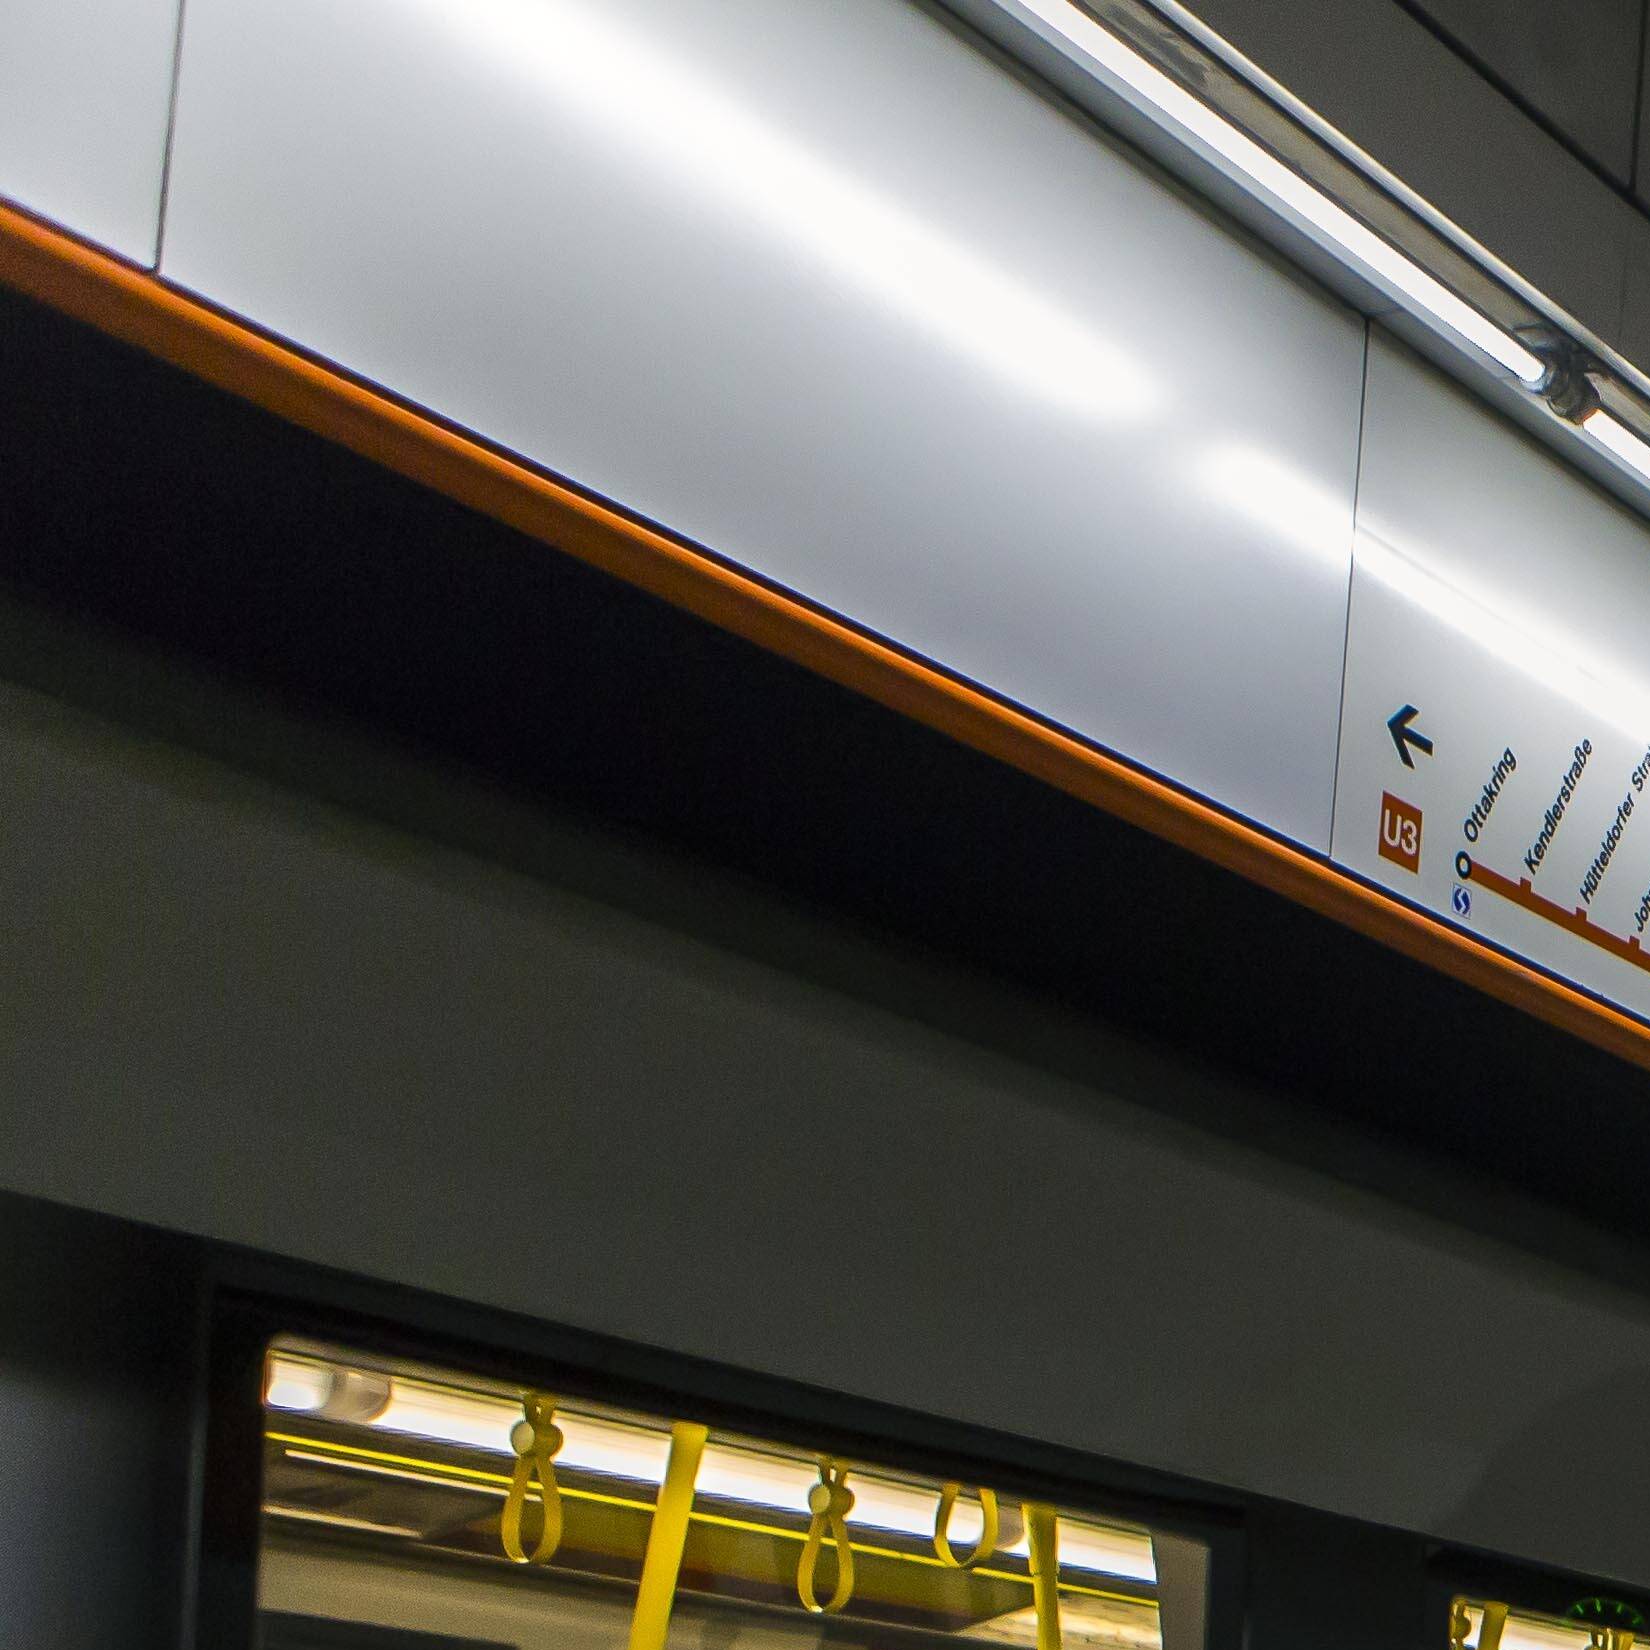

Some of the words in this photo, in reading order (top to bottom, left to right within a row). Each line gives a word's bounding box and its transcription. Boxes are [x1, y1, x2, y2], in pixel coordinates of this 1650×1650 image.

[1383, 808, 1418, 856] U3
[1463, 746, 1518, 842] Ottakring
[1524, 738, 1592, 875] Kendlerstraße
[1579, 792, 1635, 904] Hütteldorfer
